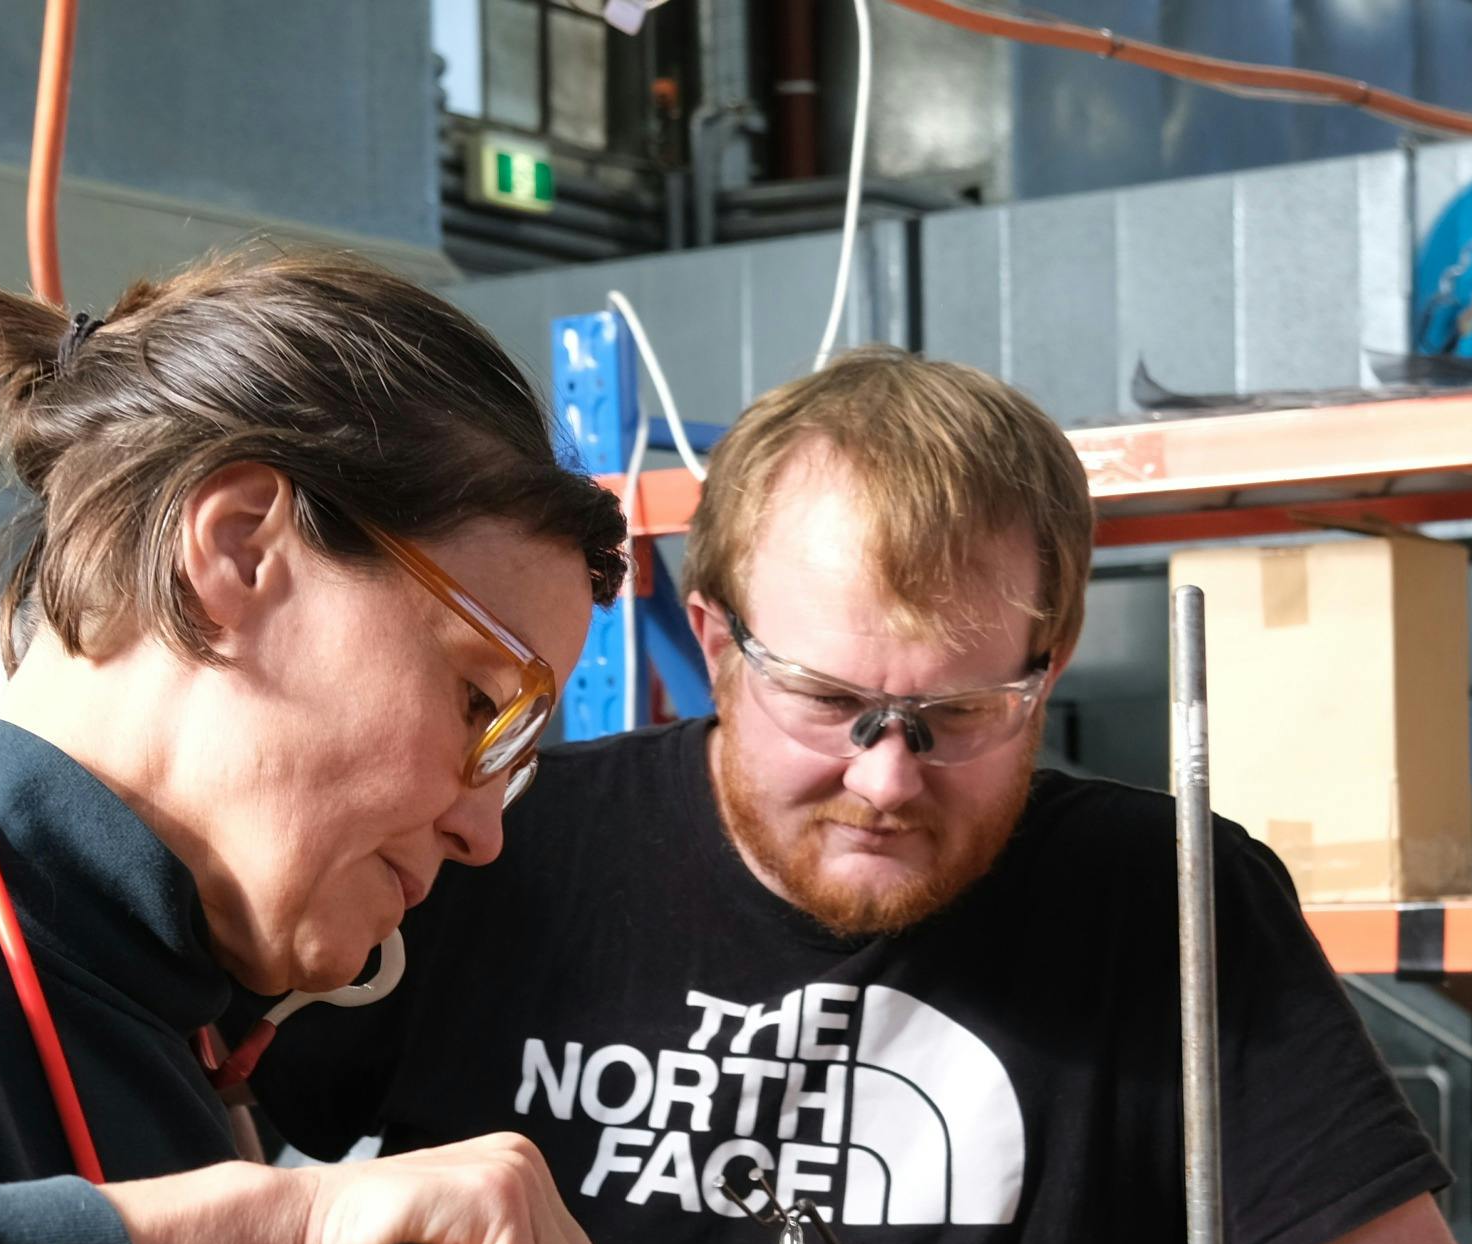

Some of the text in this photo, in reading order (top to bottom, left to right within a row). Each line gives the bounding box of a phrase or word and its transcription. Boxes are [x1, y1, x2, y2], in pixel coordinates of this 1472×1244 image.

[686, 983, 859, 1062] THE
[514, 1037, 848, 1144] NORTH
[580, 1126, 839, 1223] FACE
